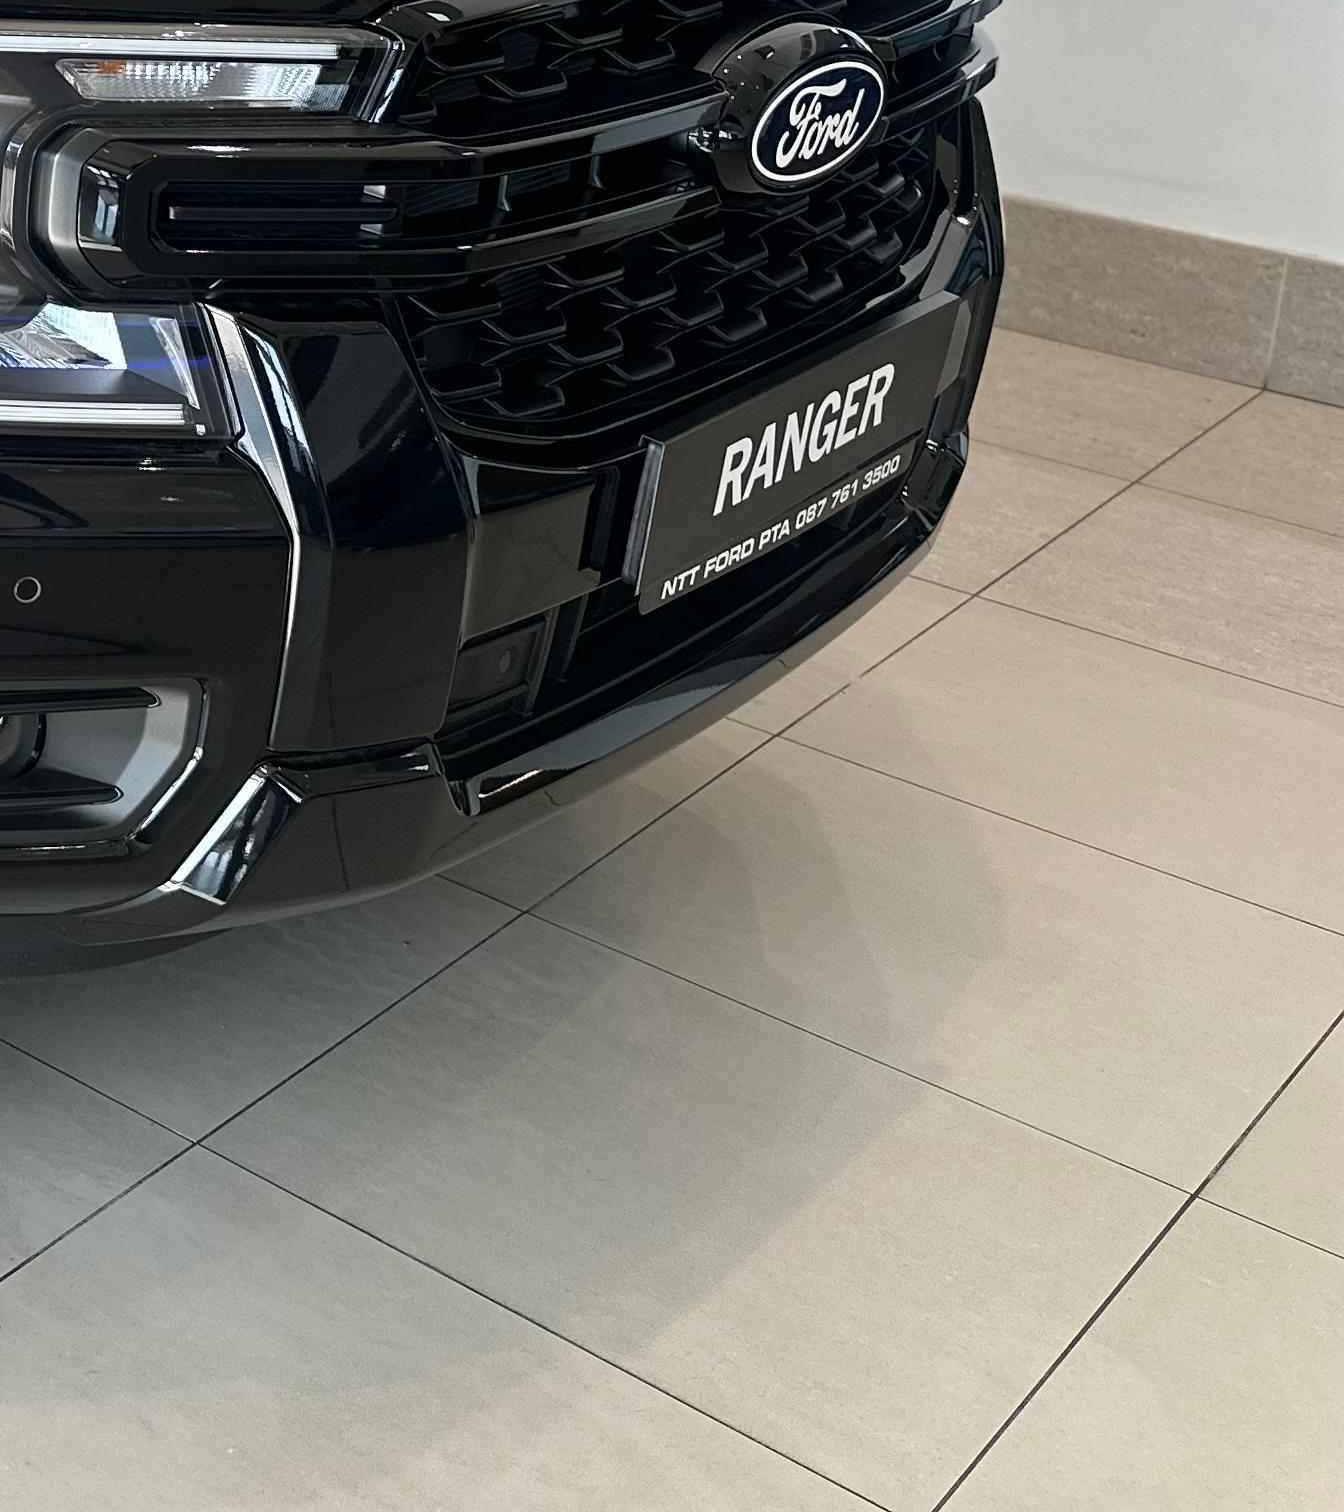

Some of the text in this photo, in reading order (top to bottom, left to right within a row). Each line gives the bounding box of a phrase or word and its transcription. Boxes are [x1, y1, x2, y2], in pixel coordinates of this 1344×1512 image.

[775, 78, 866, 169] Ford
[713, 362, 896, 517] RANGER
[661, 454, 902, 600] NTT FORD PTA 087 761 3500
